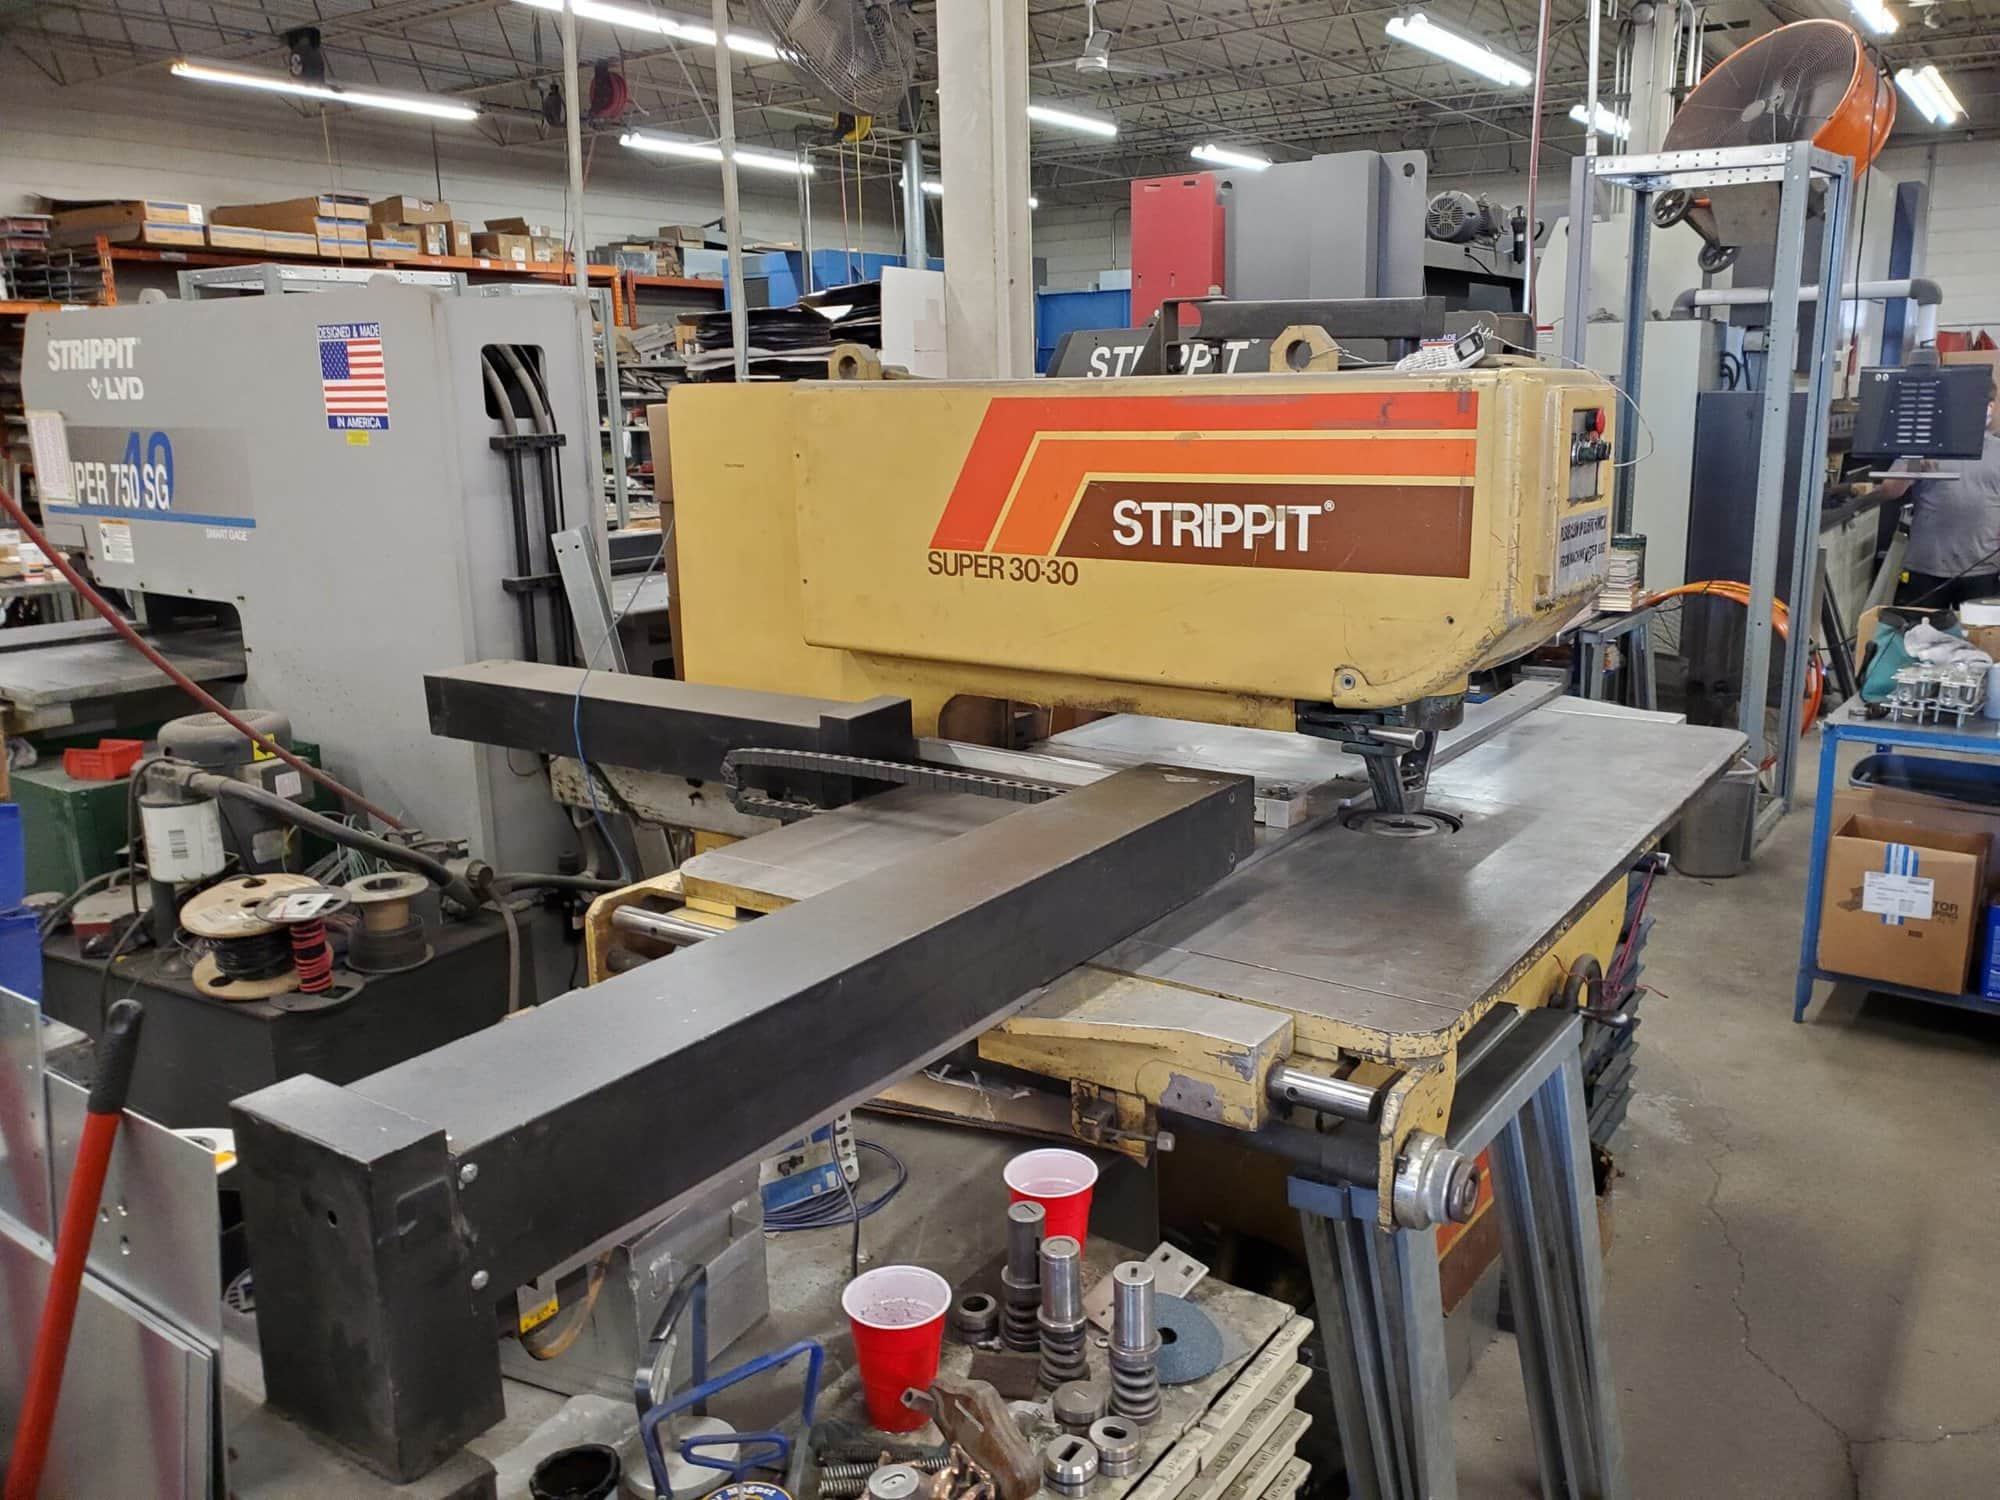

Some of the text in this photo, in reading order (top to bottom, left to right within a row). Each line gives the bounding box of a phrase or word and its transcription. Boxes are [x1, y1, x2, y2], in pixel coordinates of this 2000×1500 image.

[319, 327, 351, 339] DESIGNED
[359, 323, 380, 338] MADE
[48, 337, 137, 371] STRIPPIT
[105, 376, 144, 400] LVD
[337, 416, 382, 428] IN AMERICA
[110, 463, 140, 509] 750
[143, 463, 170, 510] SG
[927, 550, 1004, 580] SUPER
